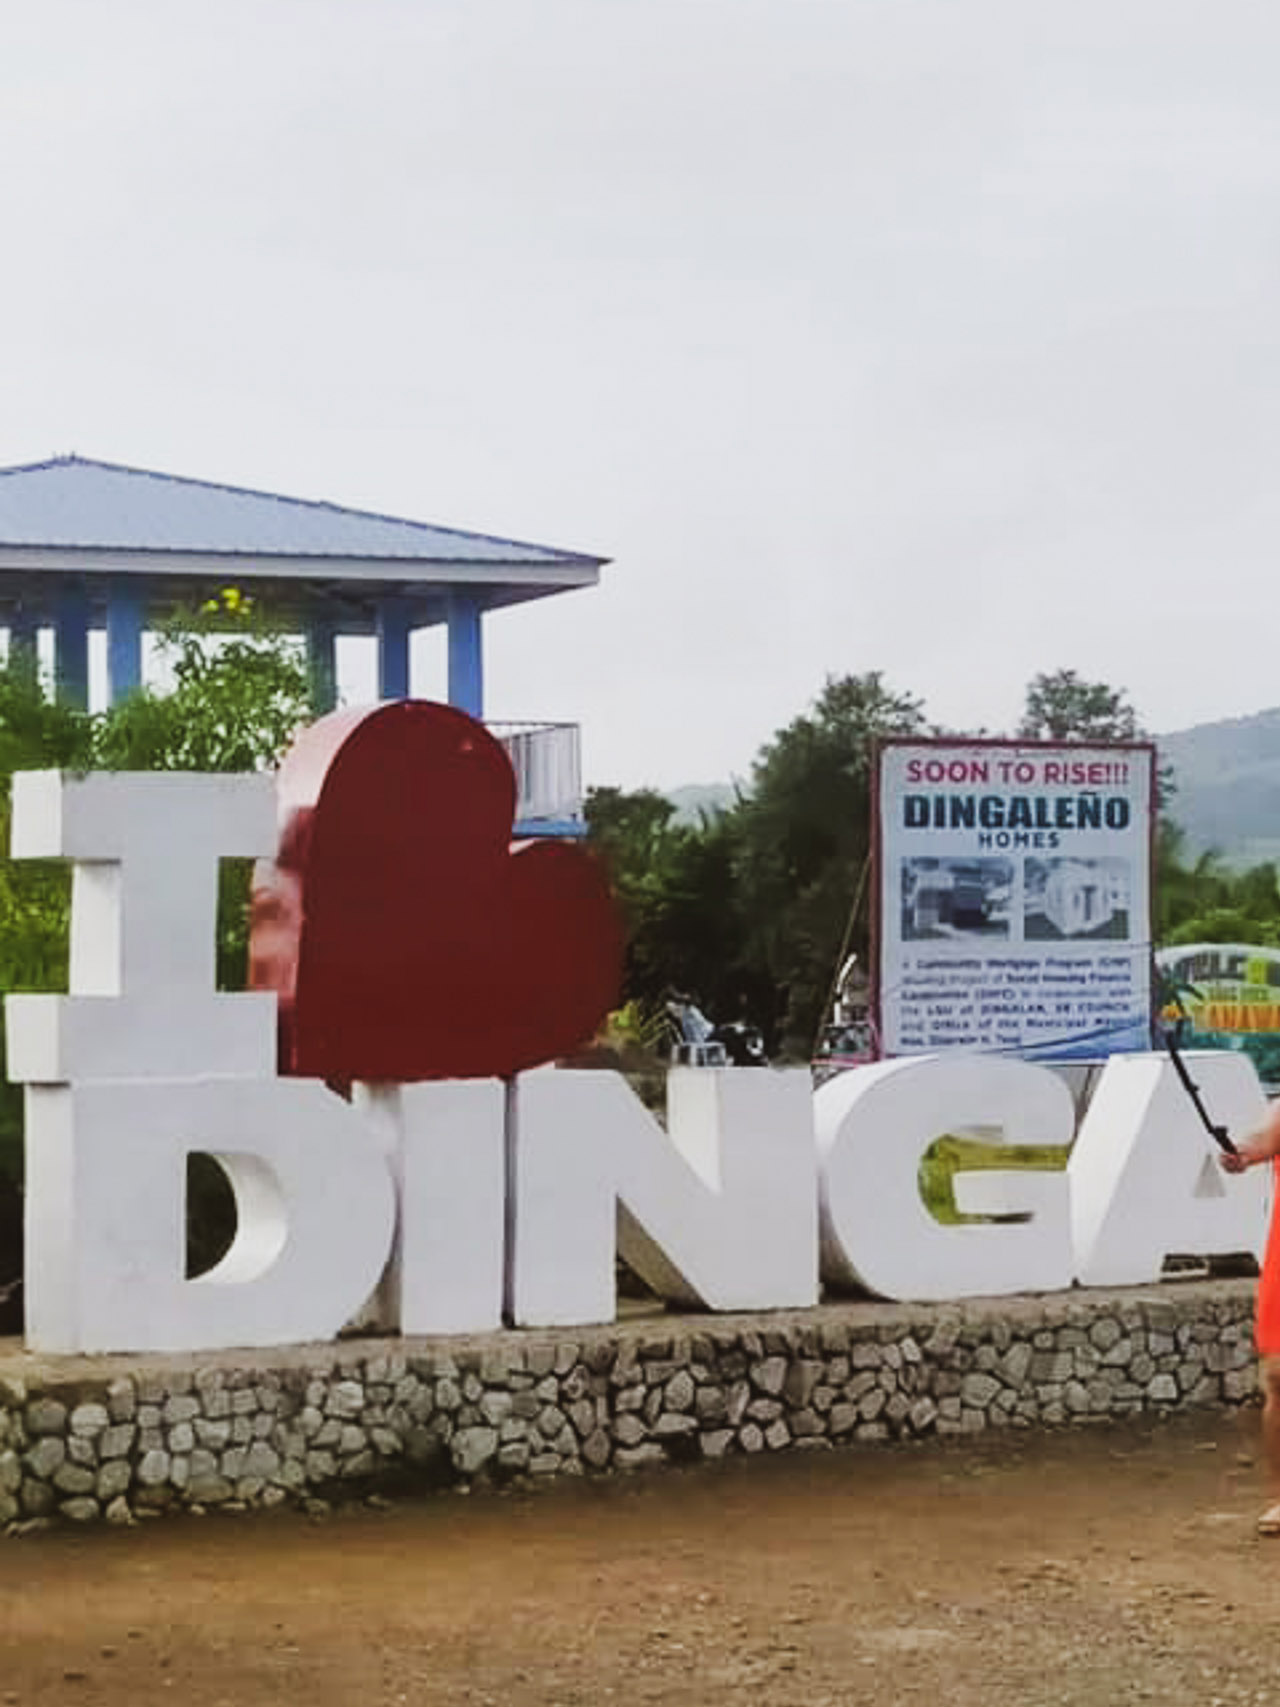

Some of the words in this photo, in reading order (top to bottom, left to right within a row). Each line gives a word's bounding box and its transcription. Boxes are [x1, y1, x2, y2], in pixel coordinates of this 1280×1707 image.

[905, 759, 990, 783] SOON
[998, 761, 1036, 784] TO
[1044, 761, 1129, 785] RISE!!!
[903, 791, 1131, 830] DINGALEÑO
[977, 831, 1061, 849] HOMES
[5, 770, 278, 1083] I
